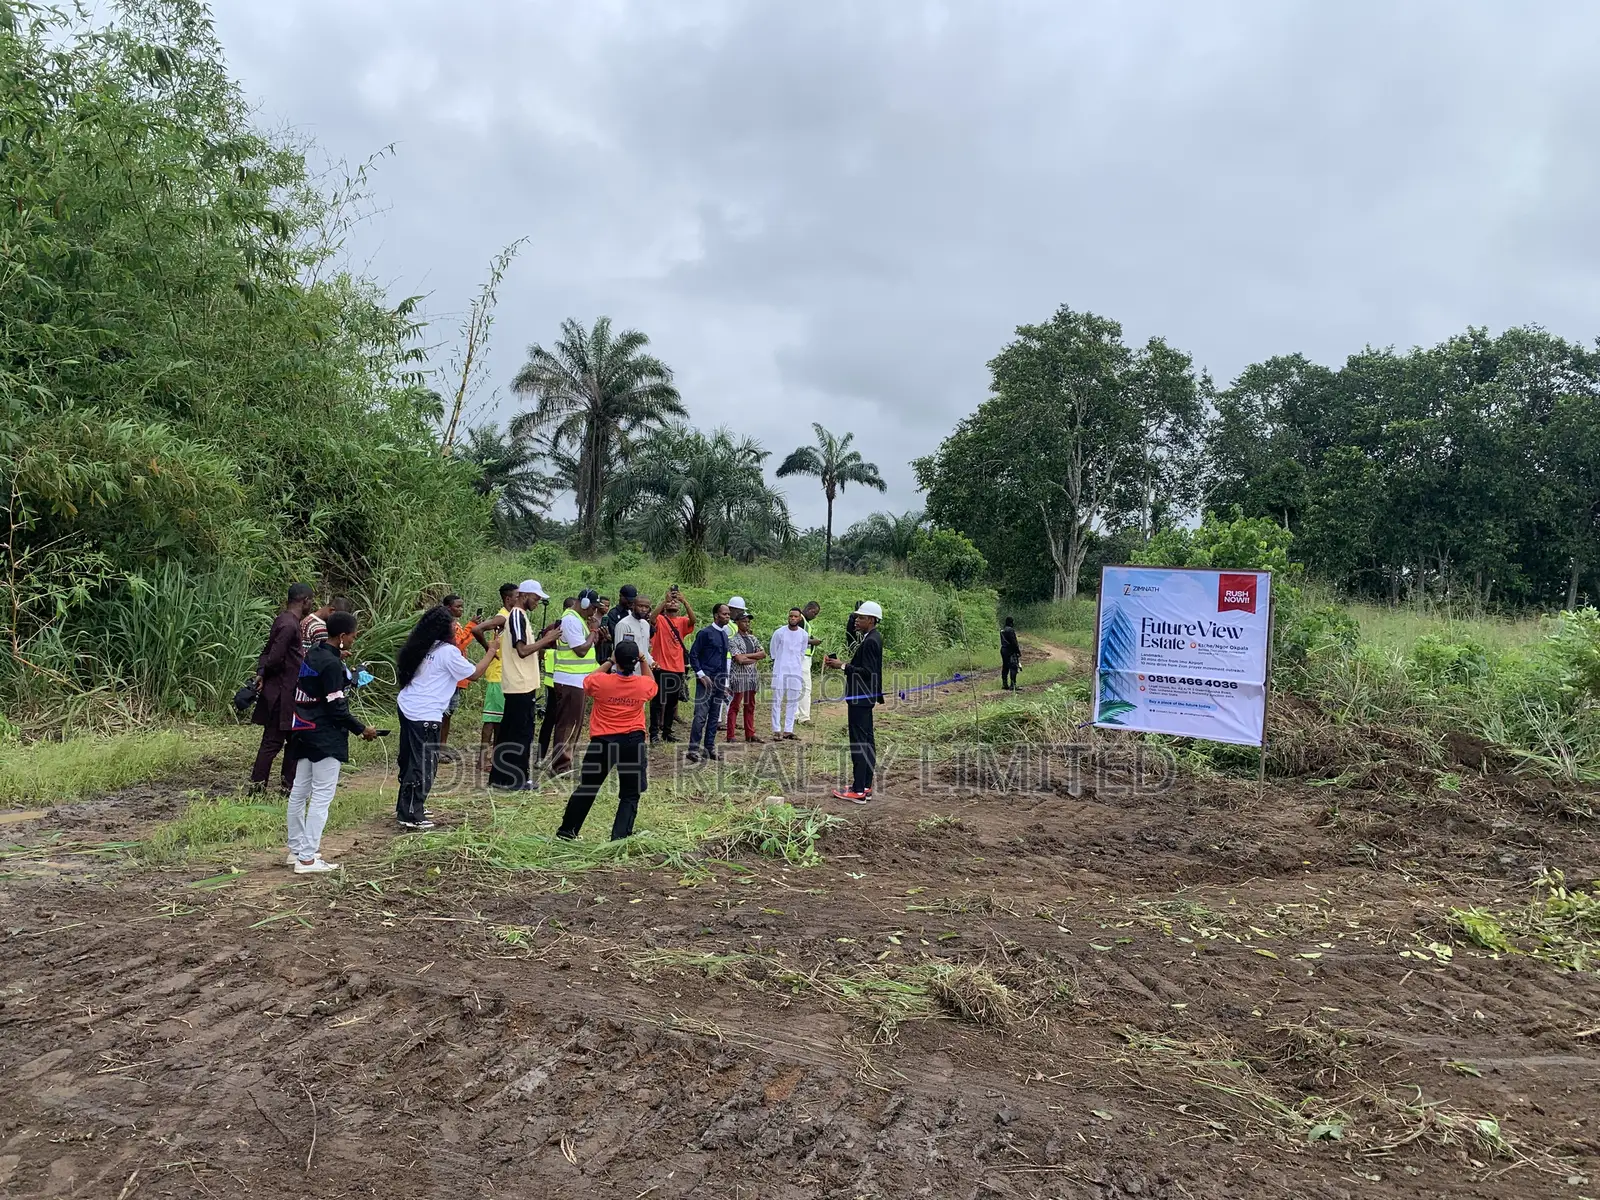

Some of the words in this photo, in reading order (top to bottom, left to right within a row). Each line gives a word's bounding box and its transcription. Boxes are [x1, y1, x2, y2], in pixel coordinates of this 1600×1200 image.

[1132, 585, 1160, 593] ZIMNATH
[1225, 590, 1249, 598] RUSH
[1224, 596, 1250, 604] NOW!!
[1140, 633, 1185, 650] Estate
[1147, 674, 1177, 684] 0816
[1178, 677, 1203, 686] 466
[1204, 679, 1238, 689] 4036
[607, 696, 640, 704] ZIMNATH
